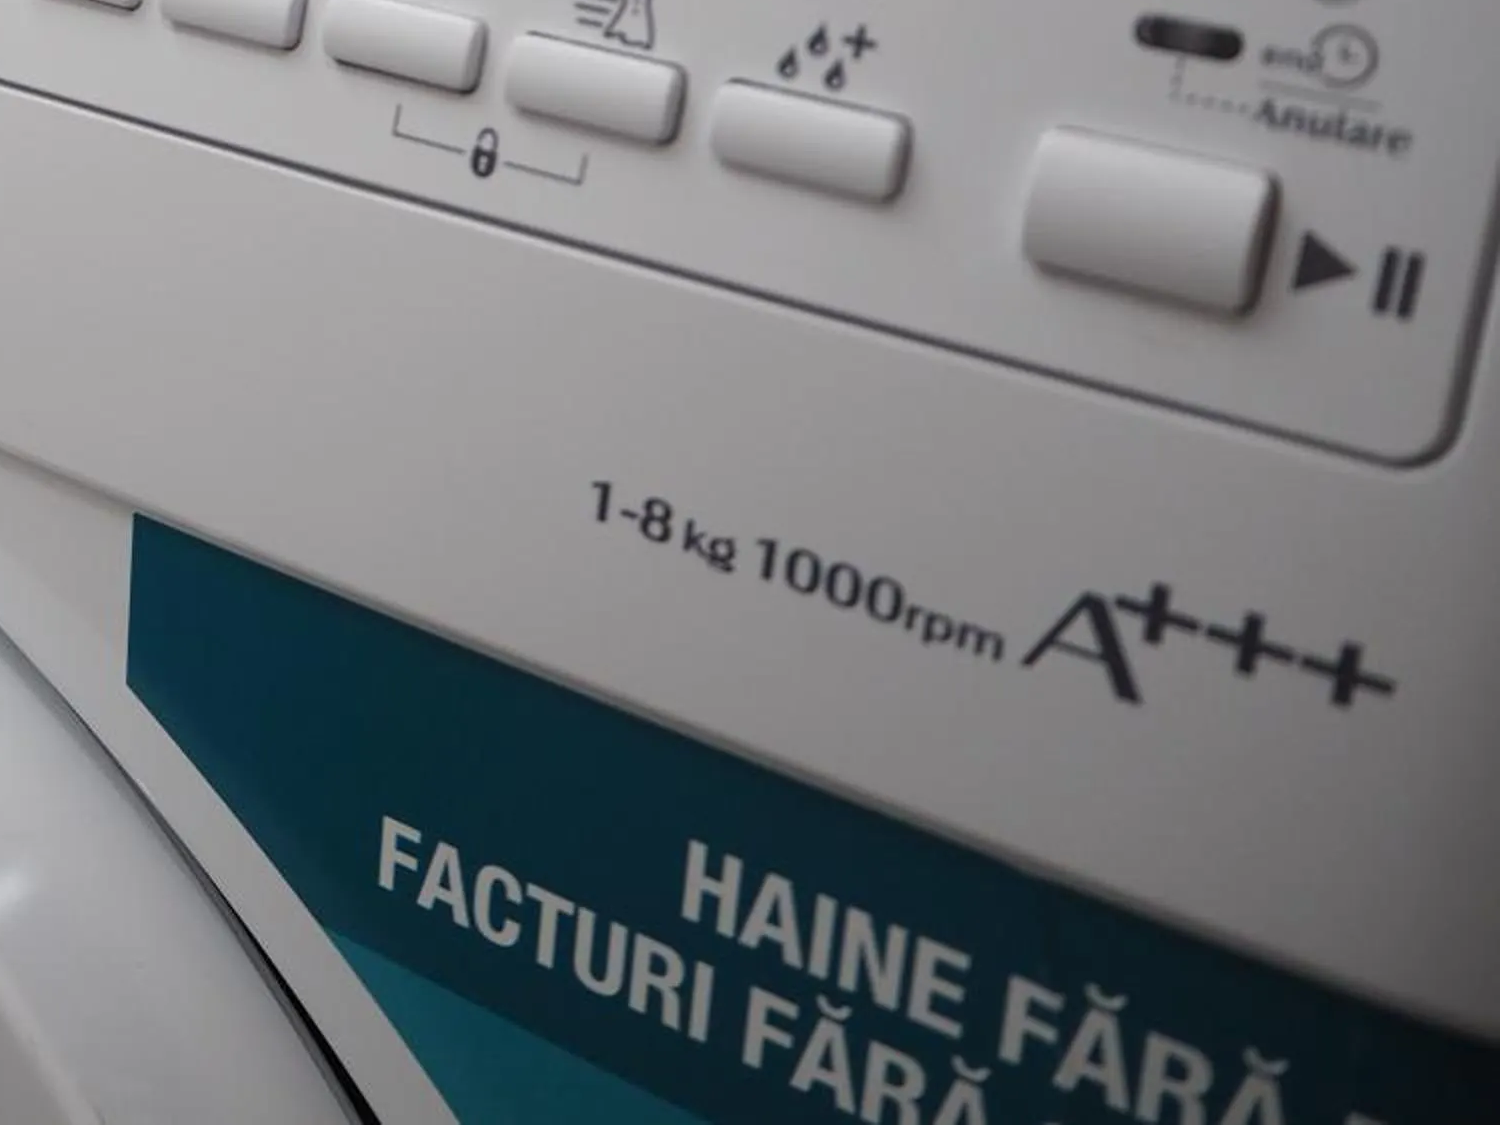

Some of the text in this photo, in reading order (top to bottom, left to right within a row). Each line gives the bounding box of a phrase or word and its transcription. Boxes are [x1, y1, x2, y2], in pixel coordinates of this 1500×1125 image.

[1255, 96, 1414, 158] Anulare
[590, 480, 674, 543] 1-8
[681, 520, 738, 573] kg
[377, 814, 714, 1043] FACTURI
[680, 839, 973, 1039] HAINE
